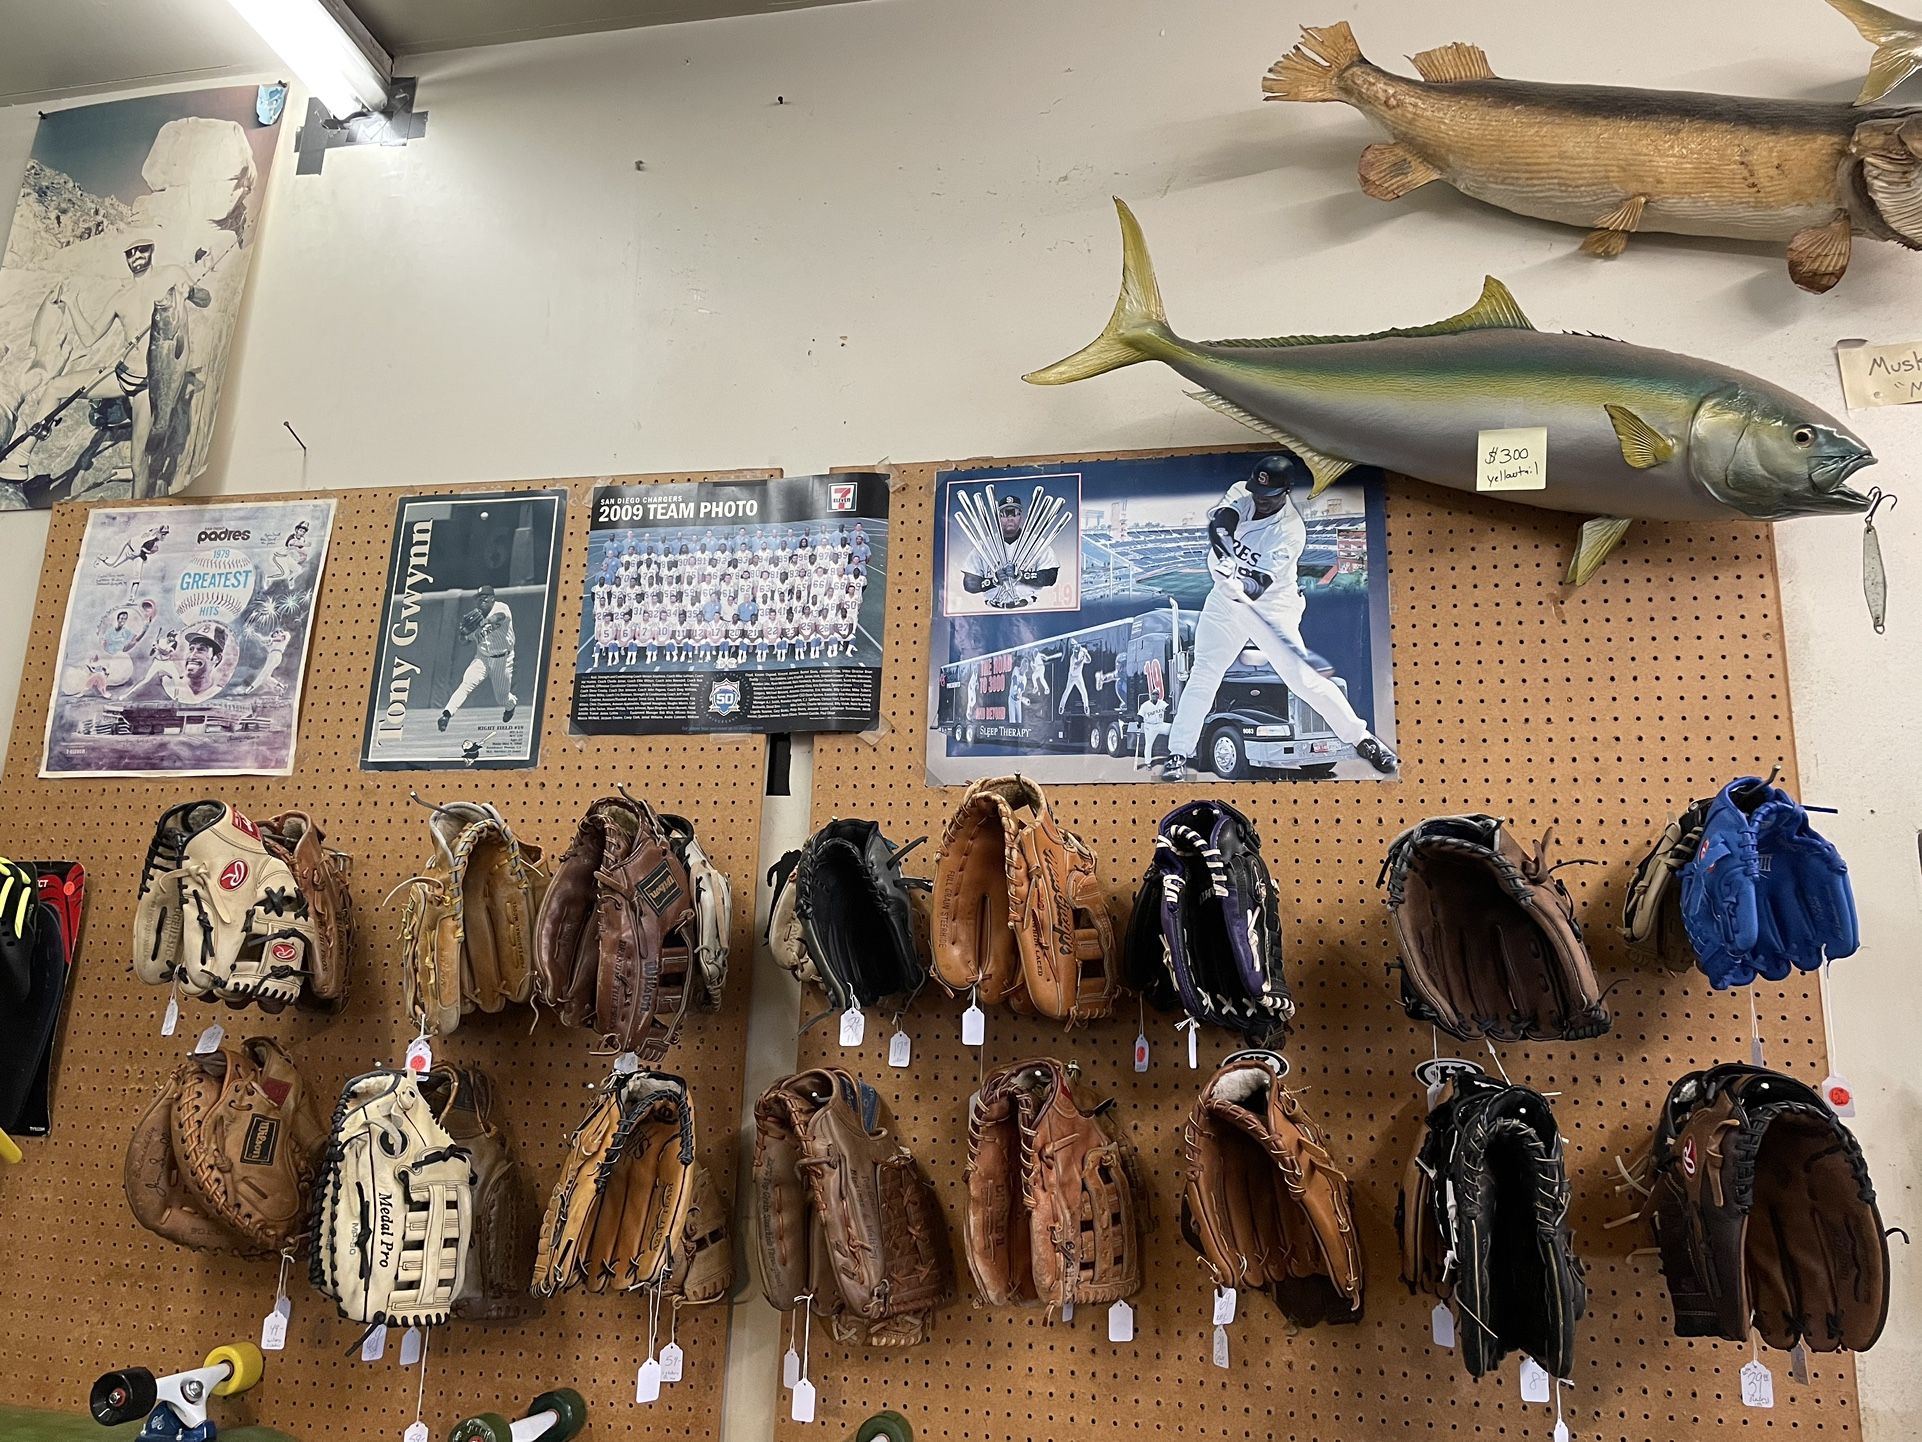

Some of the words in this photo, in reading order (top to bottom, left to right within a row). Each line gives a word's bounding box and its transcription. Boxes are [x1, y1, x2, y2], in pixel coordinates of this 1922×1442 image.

[1485, 446, 1529, 464] $300
[642, 495, 683, 504] CHARGERS
[598, 504, 643, 522] 2009
[648, 502, 695, 520] TEAM
[700, 499, 758, 518] PHOTO
[197, 528, 251, 544] padres
[213, 550, 231, 559] 1979
[180, 570, 252, 590] GREATEST
[391, 518, 434, 648] Gwynn
[200, 606, 219, 616] HITS
[980, 657, 993, 677] THE
[375, 654, 422, 750] Tony
[716, 693, 734, 705] 50
[945, 871, 955, 887] FULL
[942, 888, 953, 910] GRAIN
[1035, 950, 1043, 976] LACED
[251, 1122, 270, 1159] Wilson
[378, 1192, 394, 1237] Medal
[378, 1239, 394, 1268] Pro
